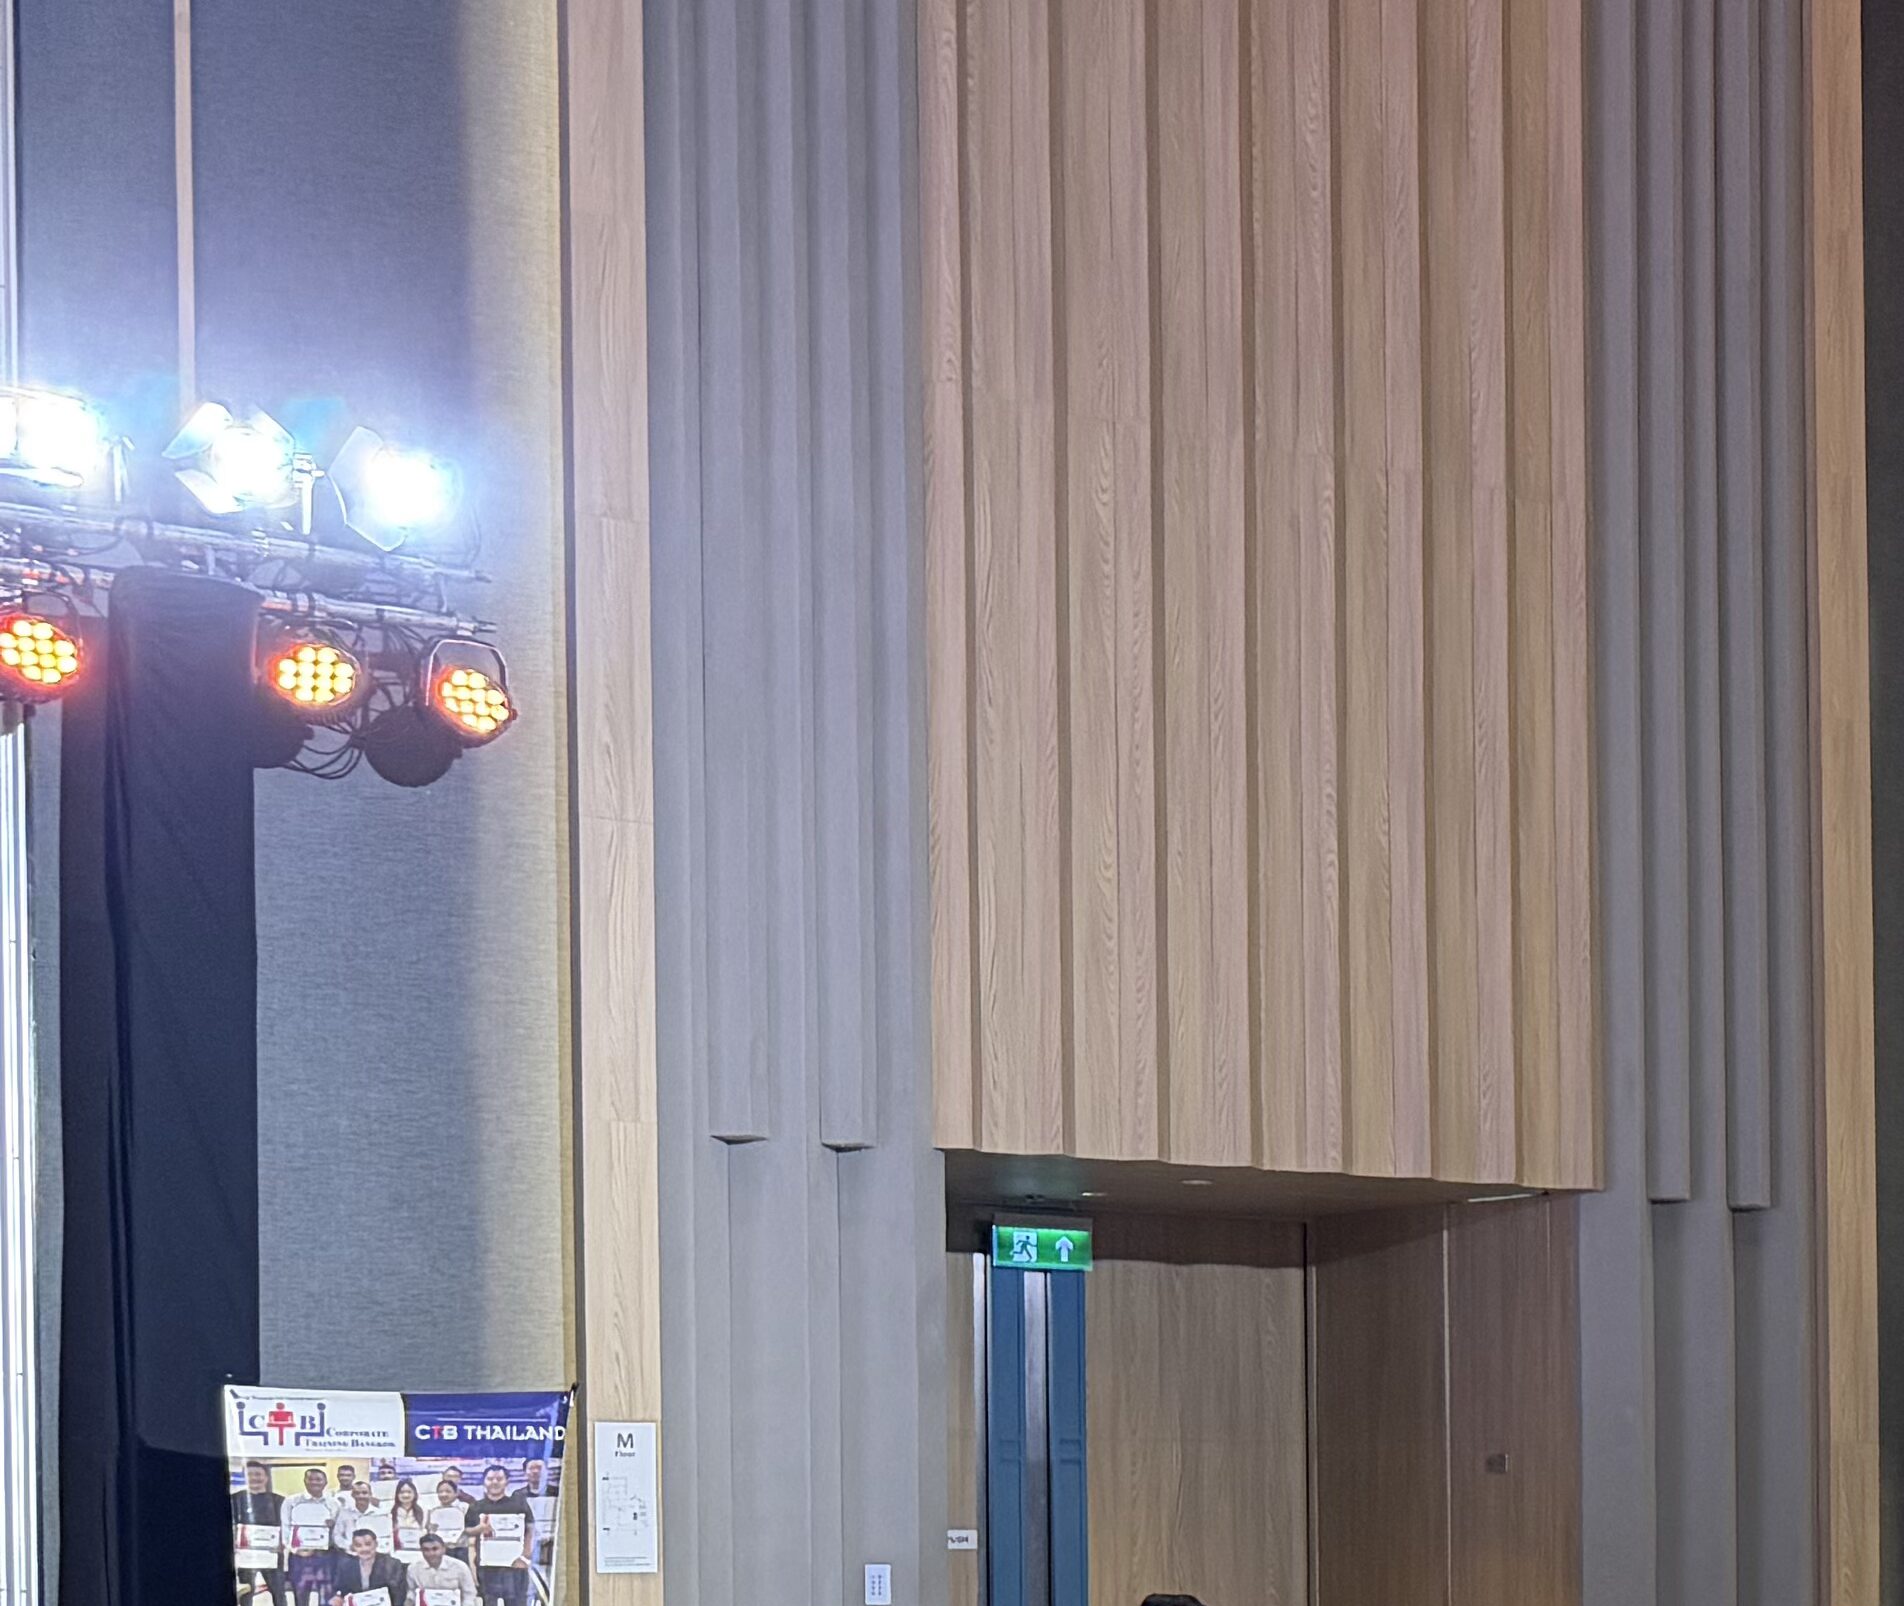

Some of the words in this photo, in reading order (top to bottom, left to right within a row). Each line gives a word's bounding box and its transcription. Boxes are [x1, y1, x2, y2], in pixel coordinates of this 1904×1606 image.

[414, 1424, 459, 1441] CTB
[462, 1423, 566, 1441] THAILAND
[617, 1433, 634, 1448] M
